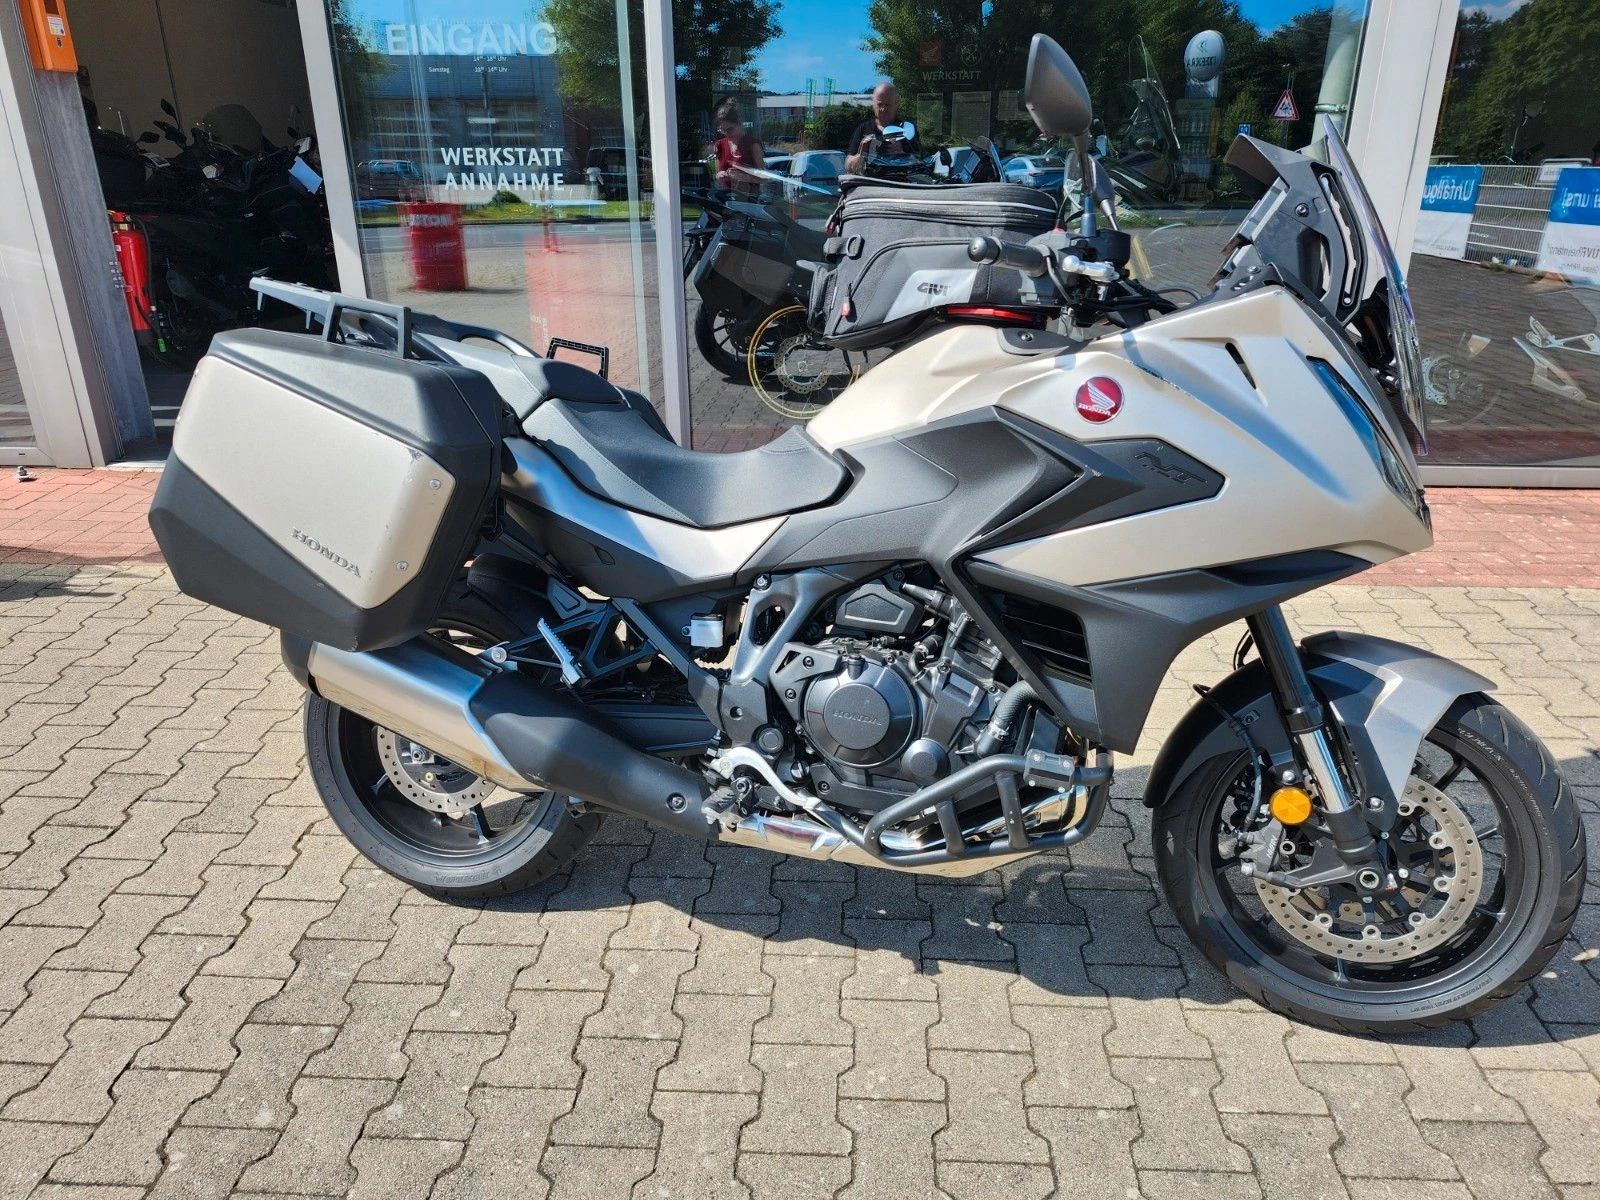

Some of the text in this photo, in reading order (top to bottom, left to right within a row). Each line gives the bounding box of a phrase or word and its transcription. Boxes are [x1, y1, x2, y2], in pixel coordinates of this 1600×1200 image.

[386, 22, 558, 56] EINGANG
[922, 70, 982, 81] WERKSTATT
[441, 147, 564, 167] WERKSTATT
[444, 173, 564, 191] ANNAHME
[1078, 402, 1112, 416] HONDA
[291, 528, 361, 578] HONDA
[832, 711, 882, 726] HONDA
